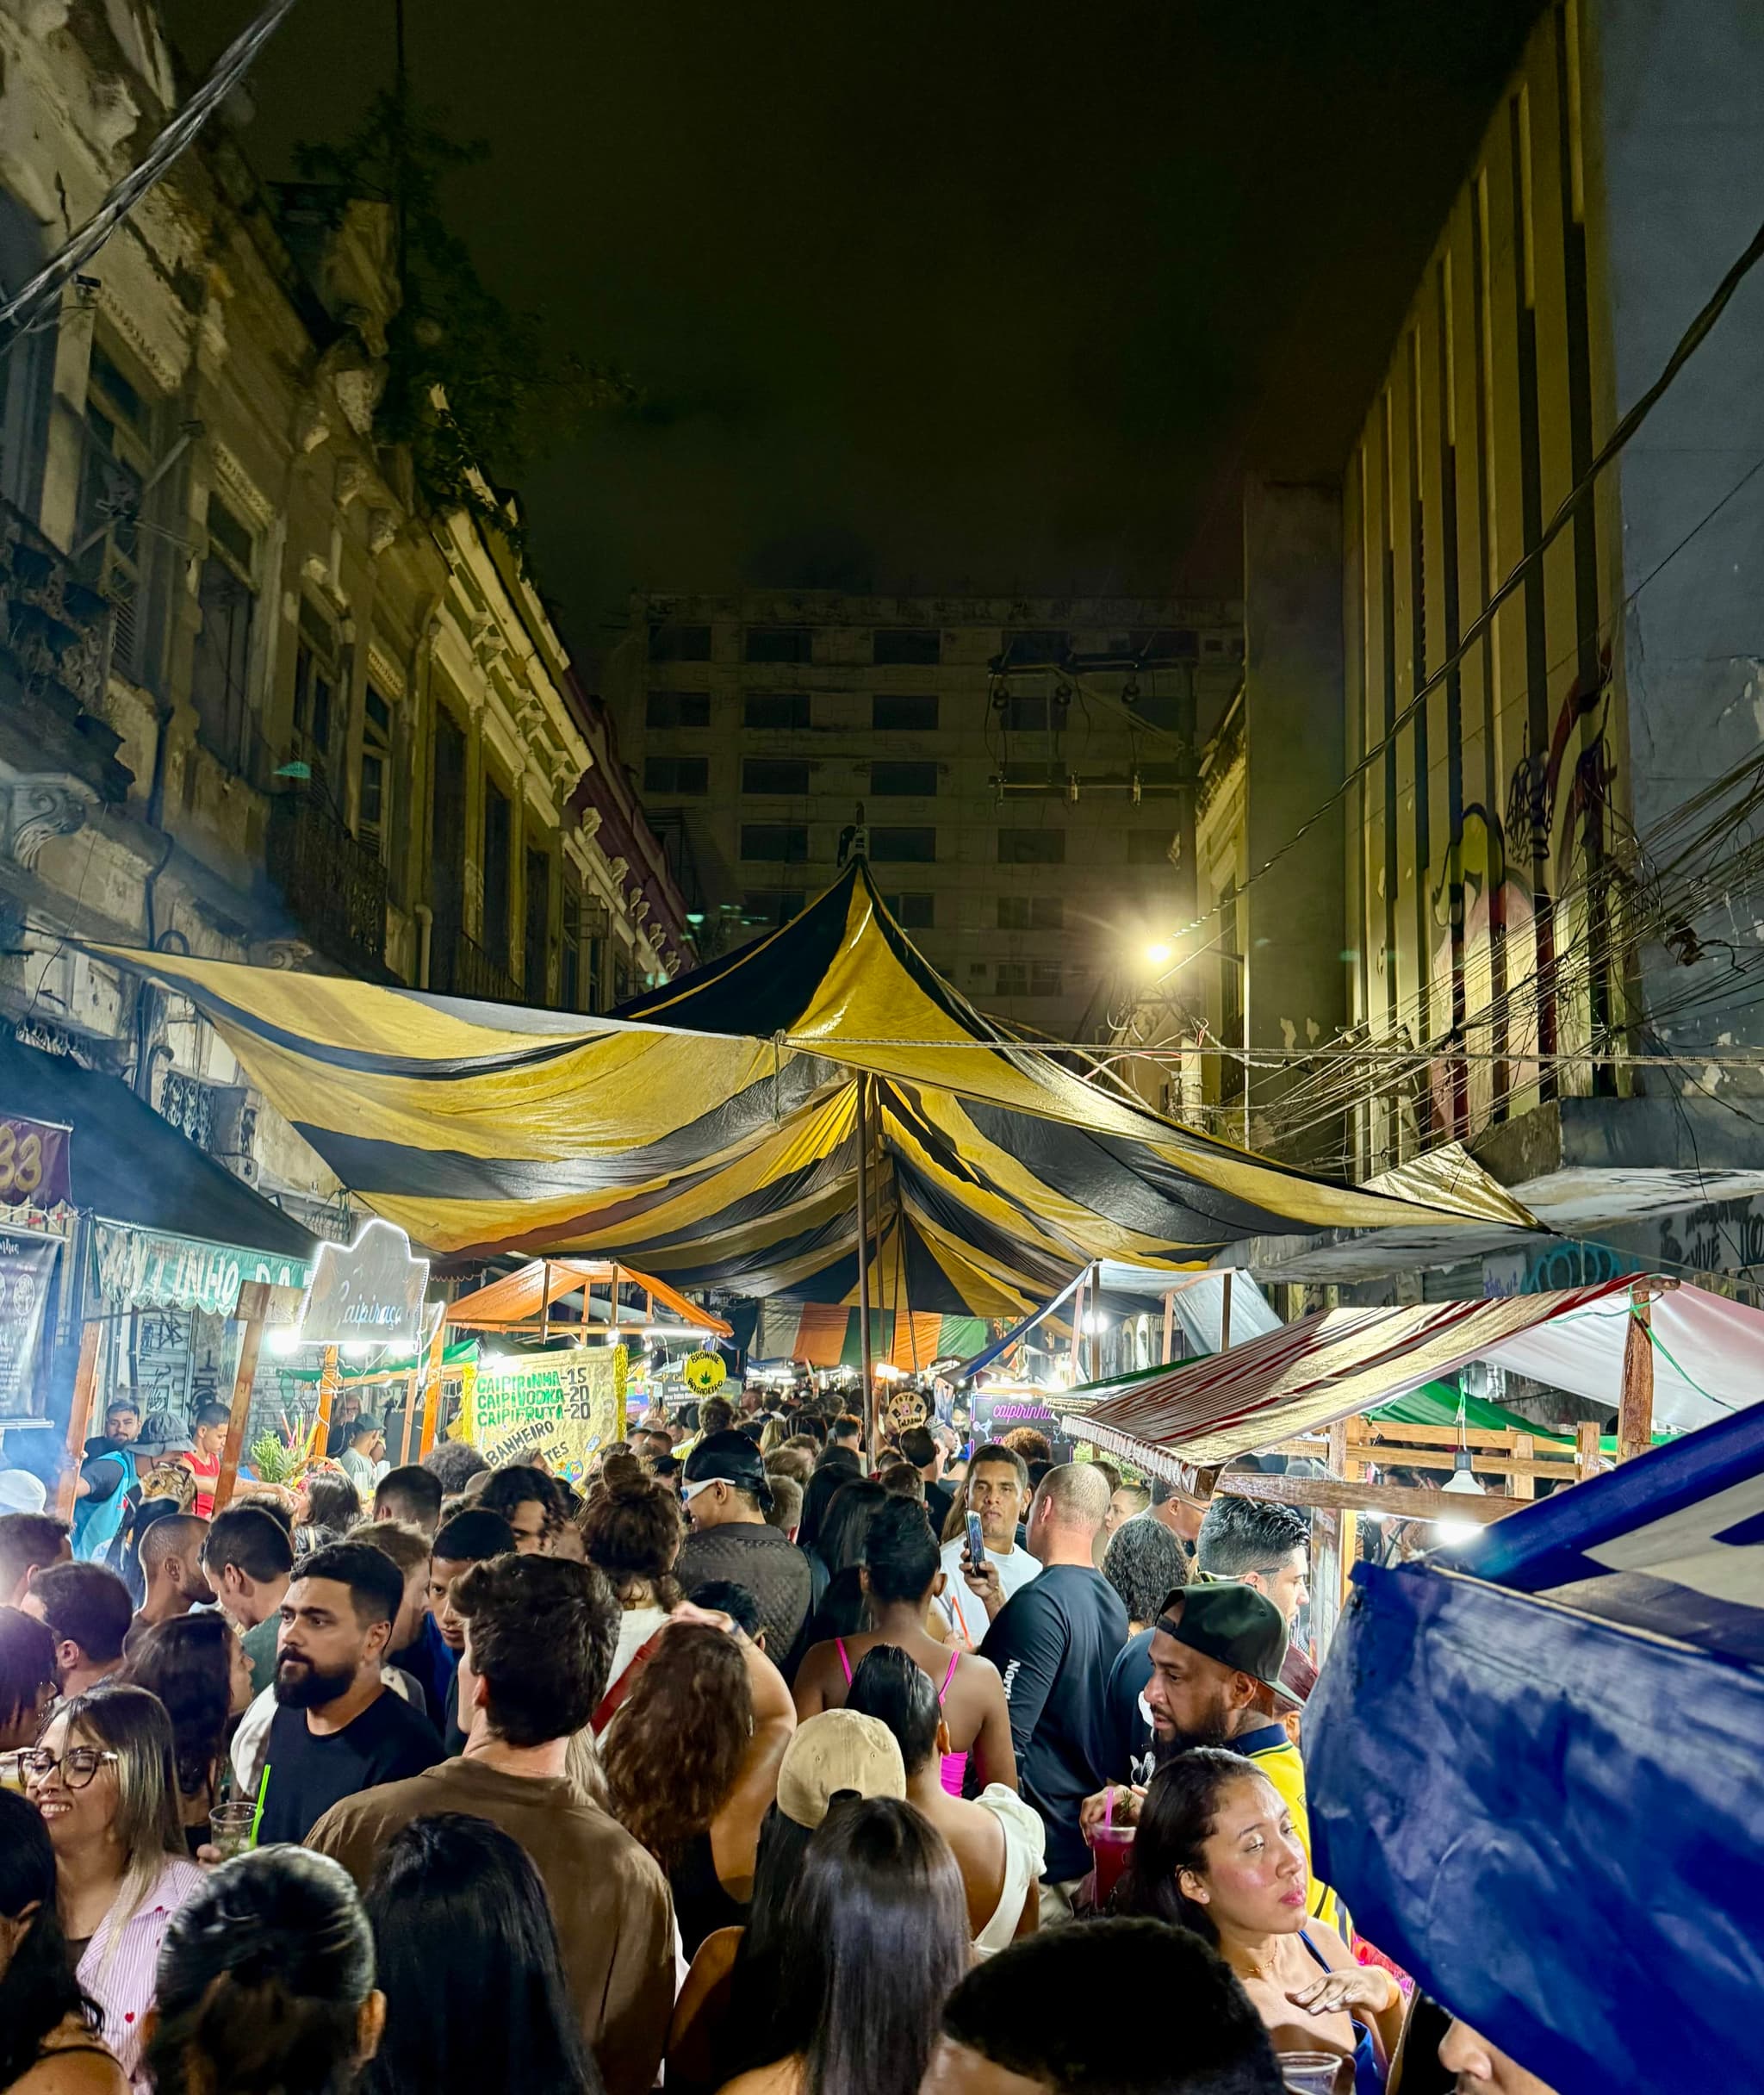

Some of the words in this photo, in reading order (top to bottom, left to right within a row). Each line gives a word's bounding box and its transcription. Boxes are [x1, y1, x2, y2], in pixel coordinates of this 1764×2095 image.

[690, 1351, 722, 1365] BROWNIE
[687, 1377, 723, 1396] BRIGADEIRO
[485, 1420, 555, 1467] BANHEIRO
